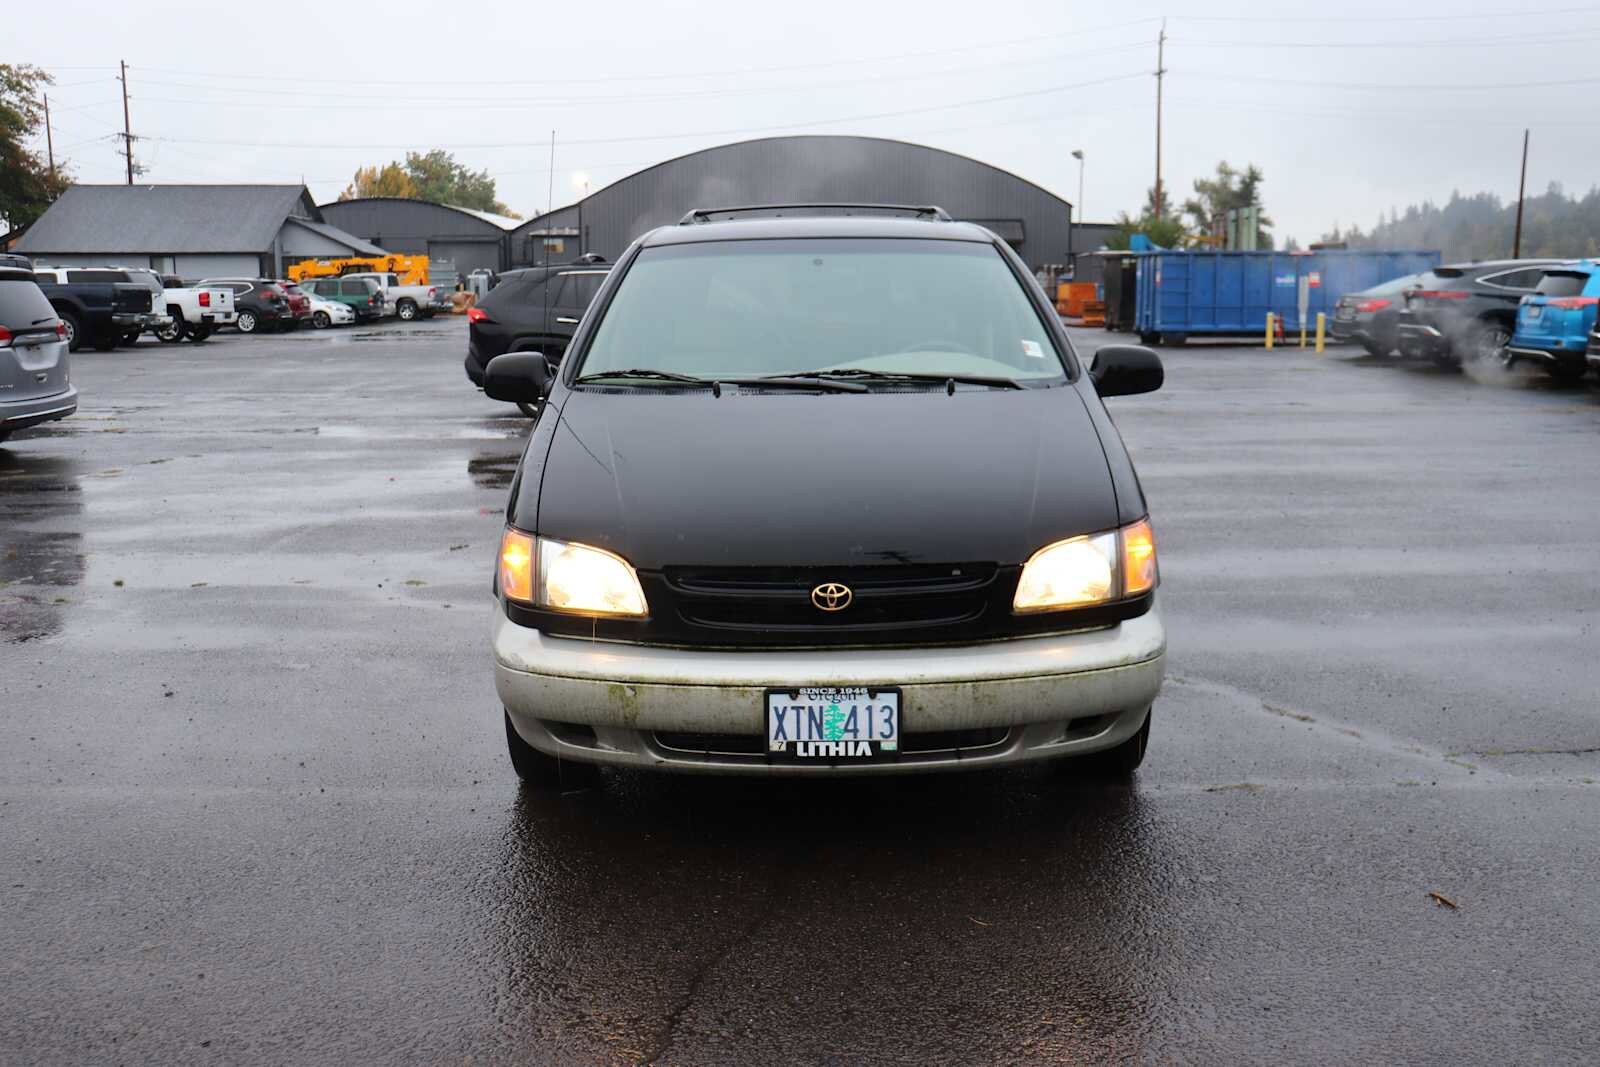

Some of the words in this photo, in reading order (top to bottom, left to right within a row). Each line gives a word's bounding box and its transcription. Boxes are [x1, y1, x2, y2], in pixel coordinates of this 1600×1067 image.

[799, 687, 836, 695] SINCE
[840, 687, 868, 695] 1946
[773, 705, 824, 740] XTN
[844, 704, 894, 739] 413
[796, 741, 873, 757] LITHIA
